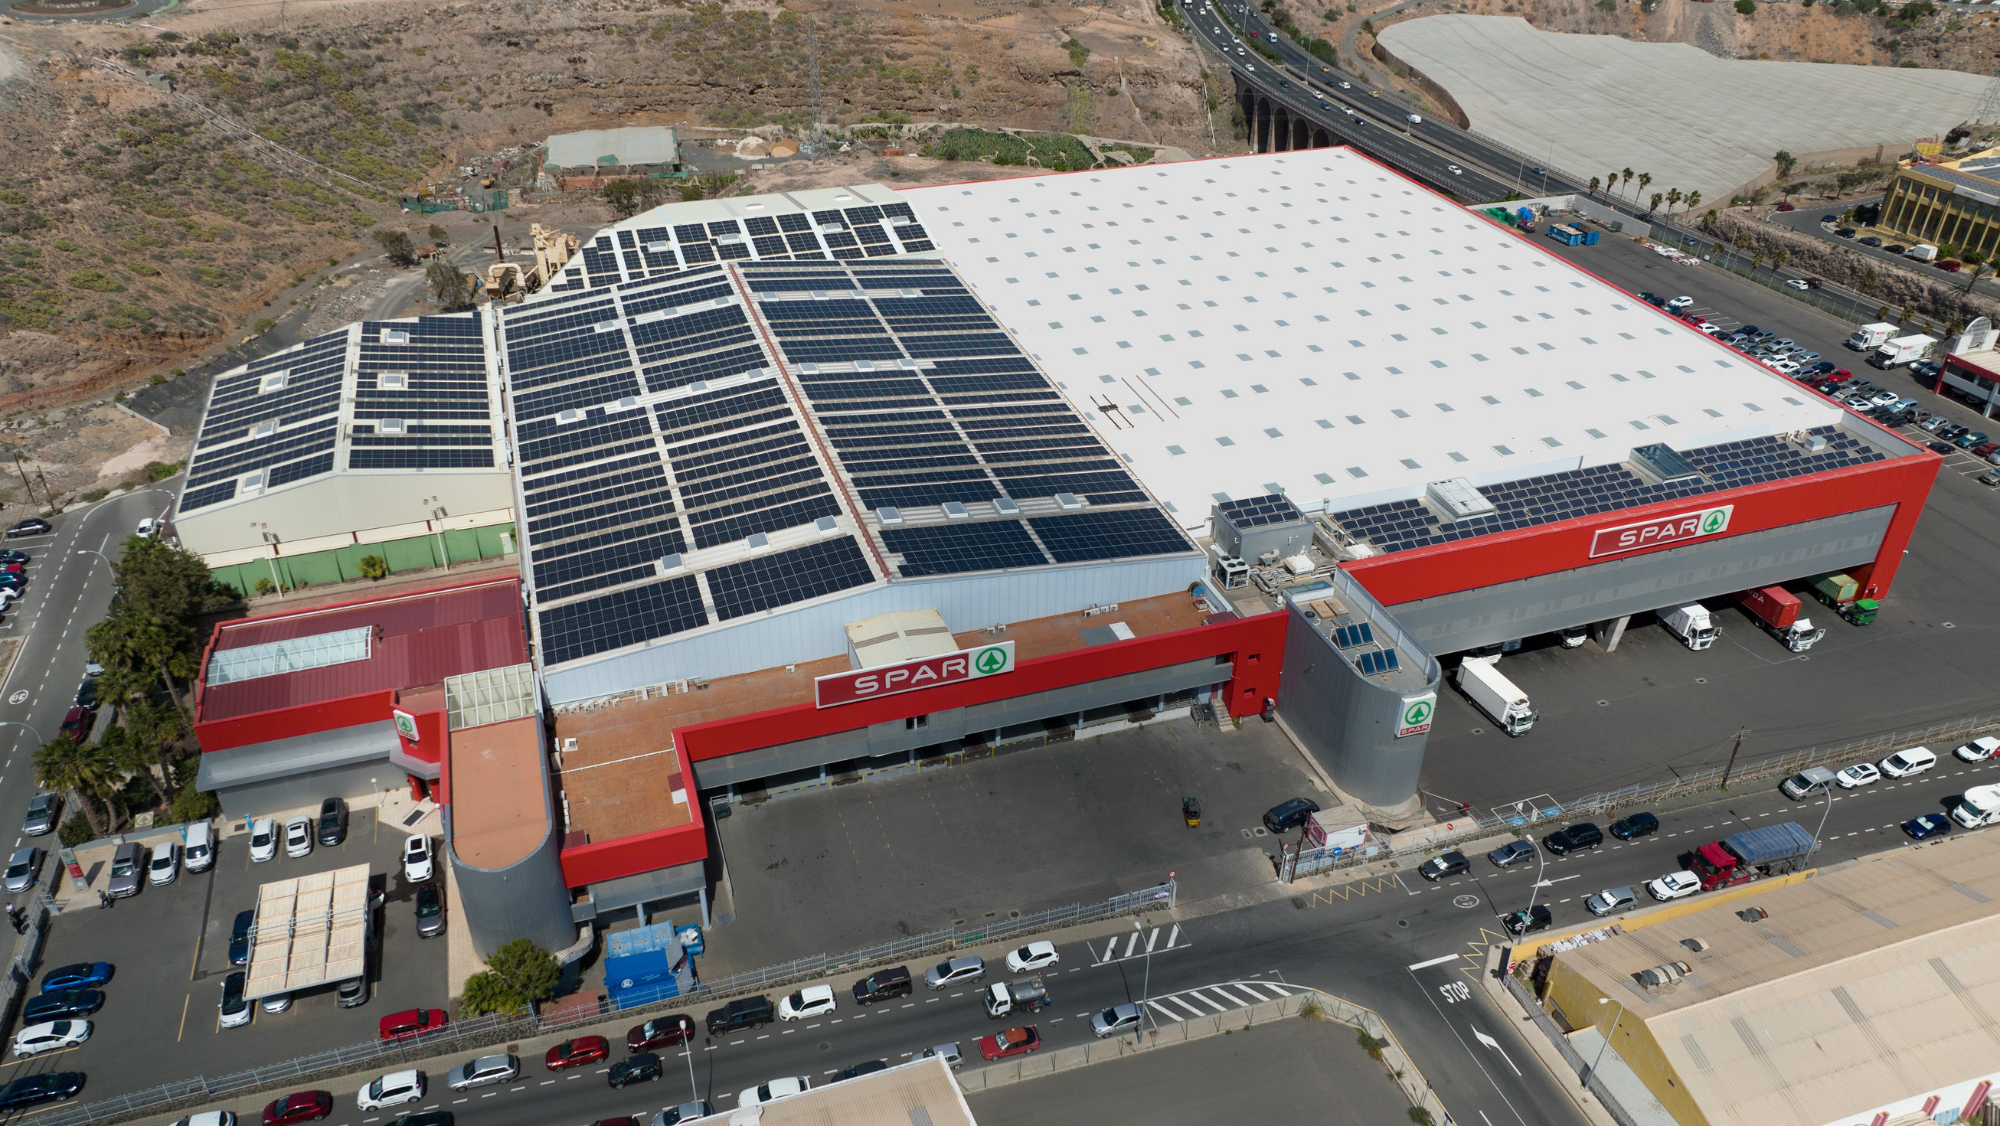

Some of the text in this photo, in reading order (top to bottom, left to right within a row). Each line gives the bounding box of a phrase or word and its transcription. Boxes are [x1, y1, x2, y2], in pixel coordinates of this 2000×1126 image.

[1618, 518, 1698, 547] SPAR
[854, 658, 966, 695] SPAR
[1401, 724, 1429, 735] SPAR
[1439, 981, 1471, 1004] STOP
